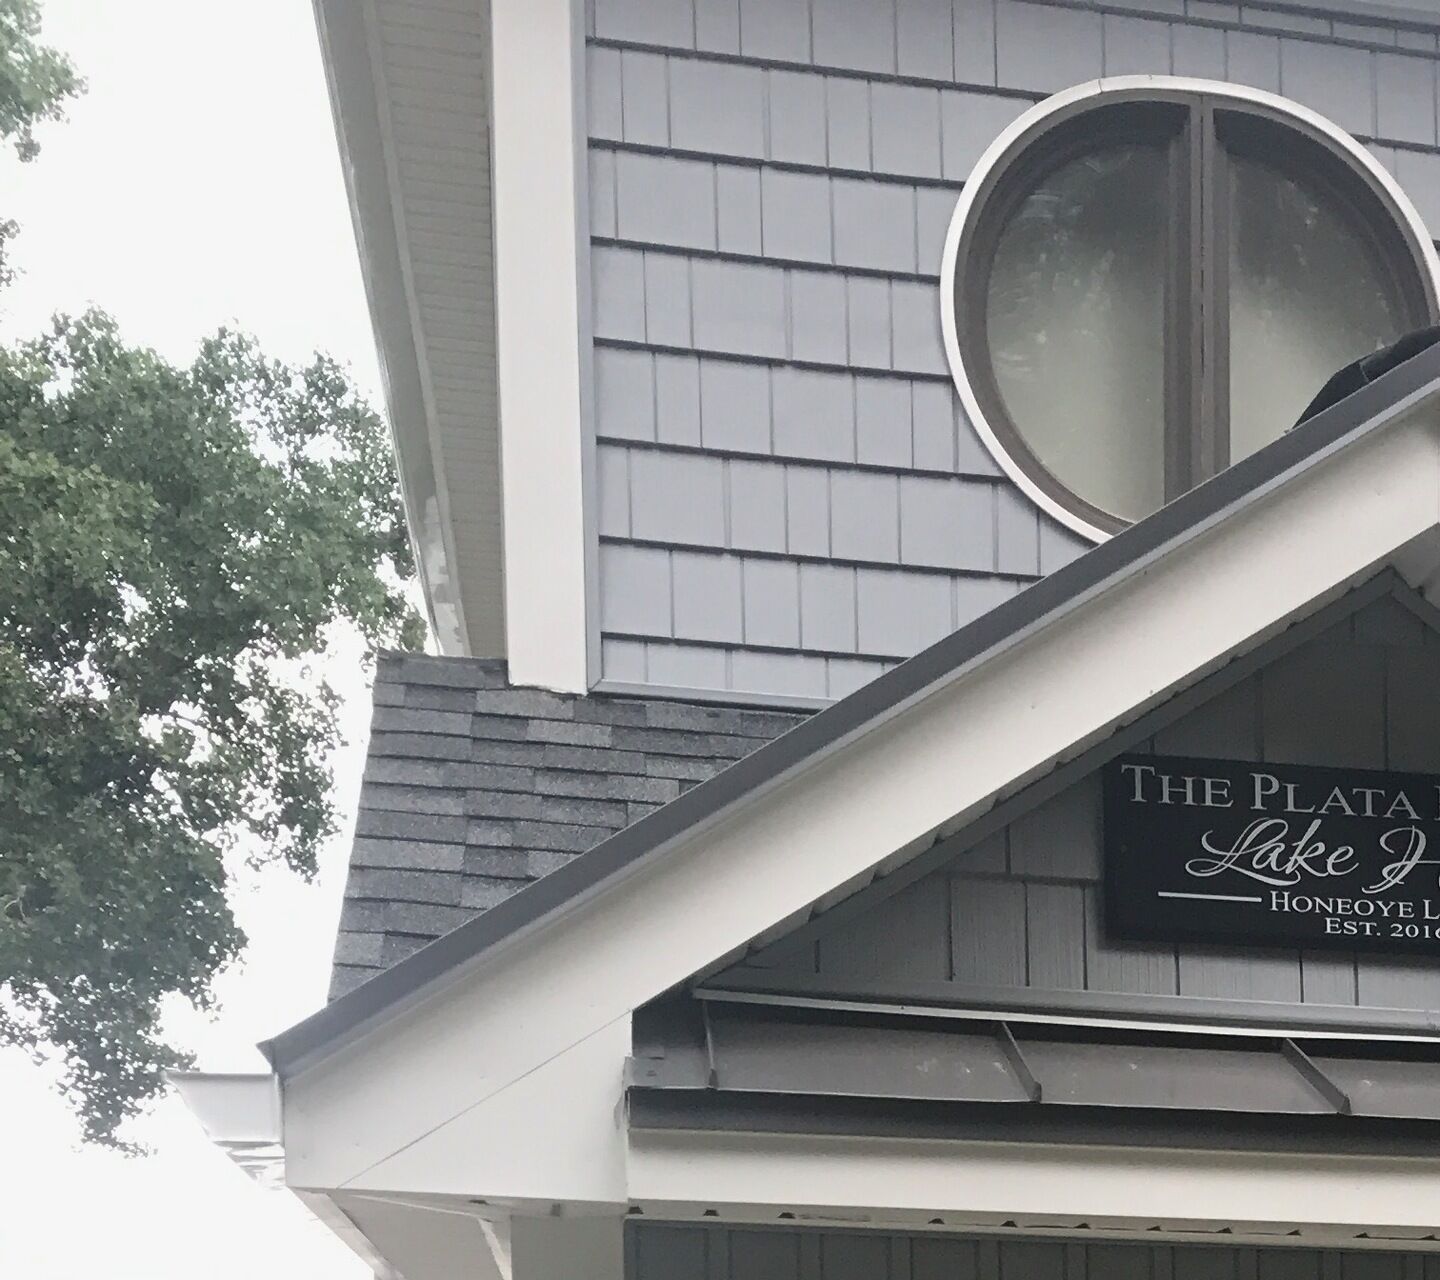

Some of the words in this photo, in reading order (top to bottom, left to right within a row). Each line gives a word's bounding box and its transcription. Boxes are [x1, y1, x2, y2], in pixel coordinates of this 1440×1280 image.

[1121, 764, 1234, 808] THE
[1249, 772, 1421, 821] PLATA
[1184, 816, 1360, 887] Lake
[1269, 889, 1415, 919] HONEOYE
[1324, 916, 1382, 938] EST.
